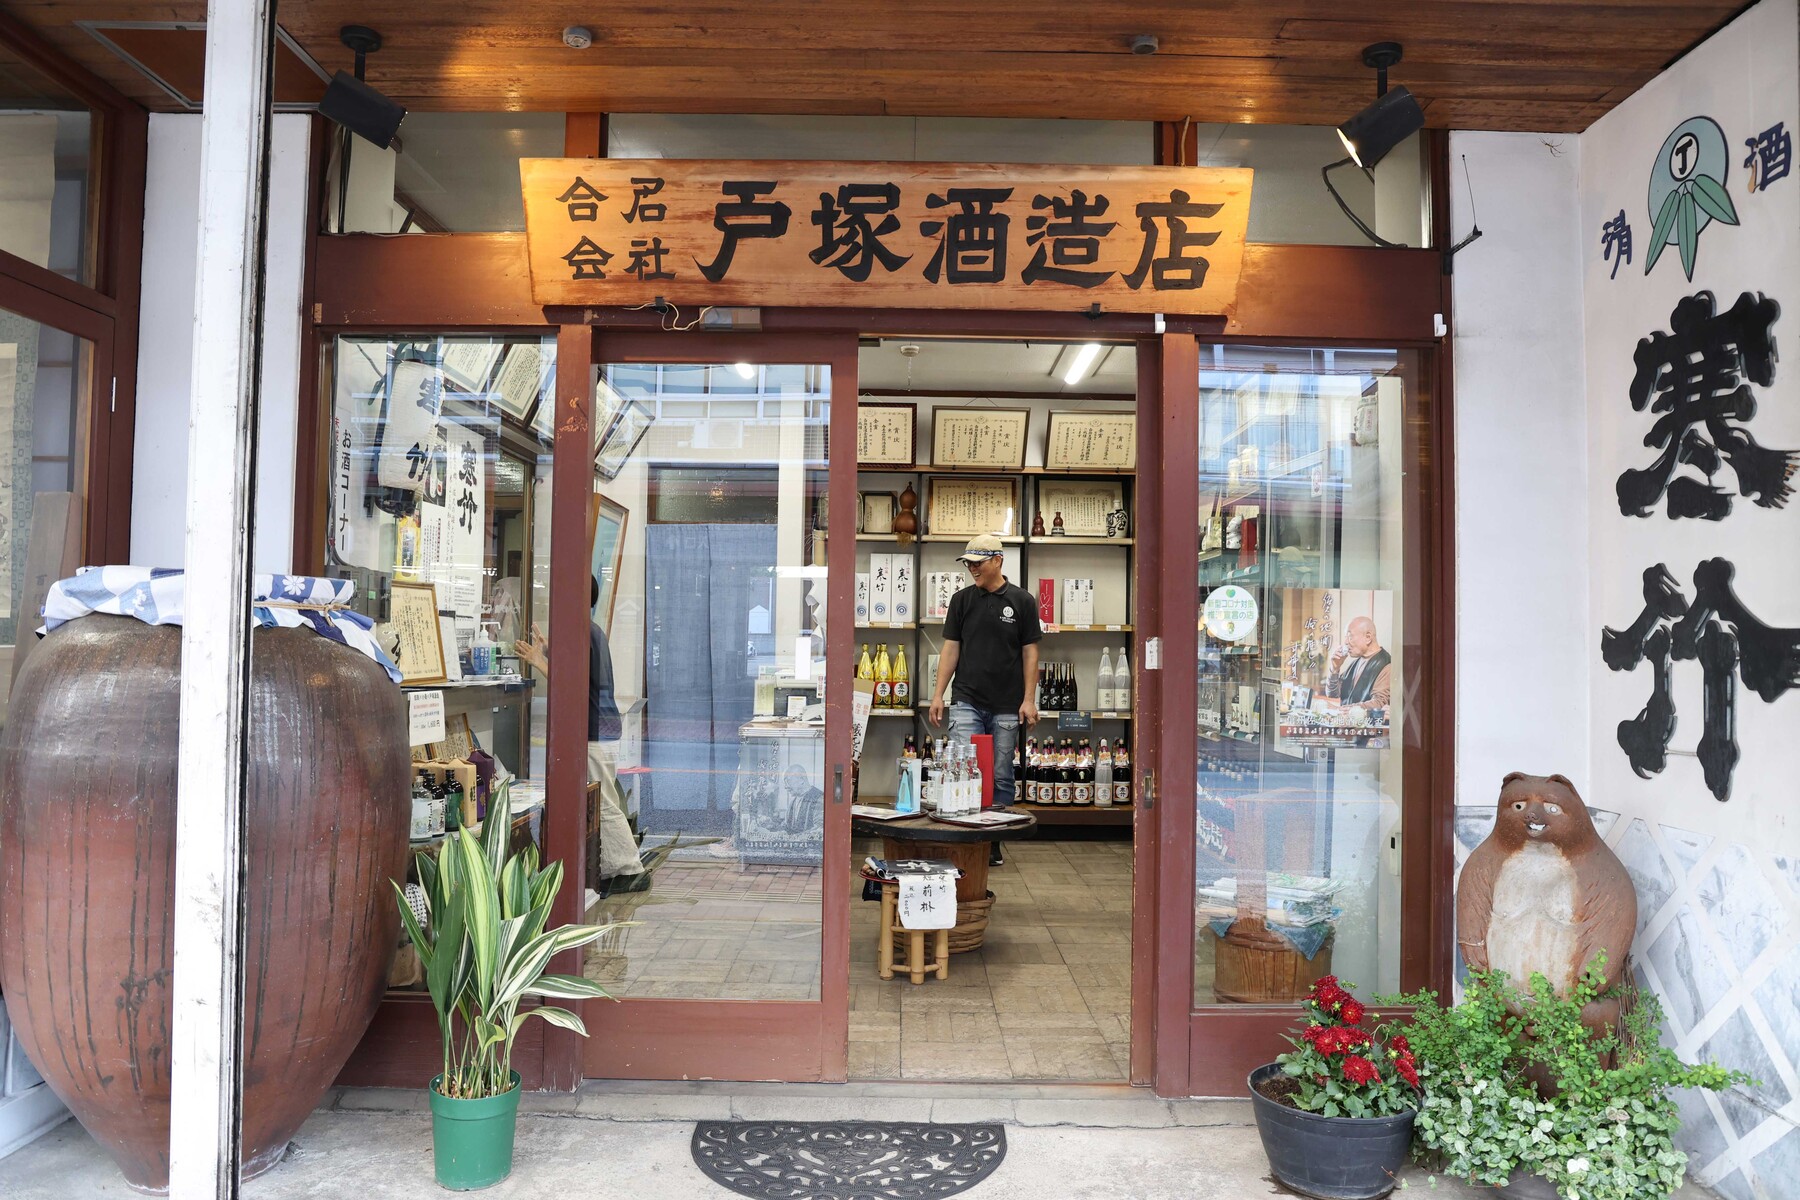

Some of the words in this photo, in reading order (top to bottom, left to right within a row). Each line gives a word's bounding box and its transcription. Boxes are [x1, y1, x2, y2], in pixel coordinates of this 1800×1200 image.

[1743, 121, 1792, 194] 酒
[692, 179, 1226, 292] 戸塚酒造店
[1600, 290, 1800, 802] 寒竹
